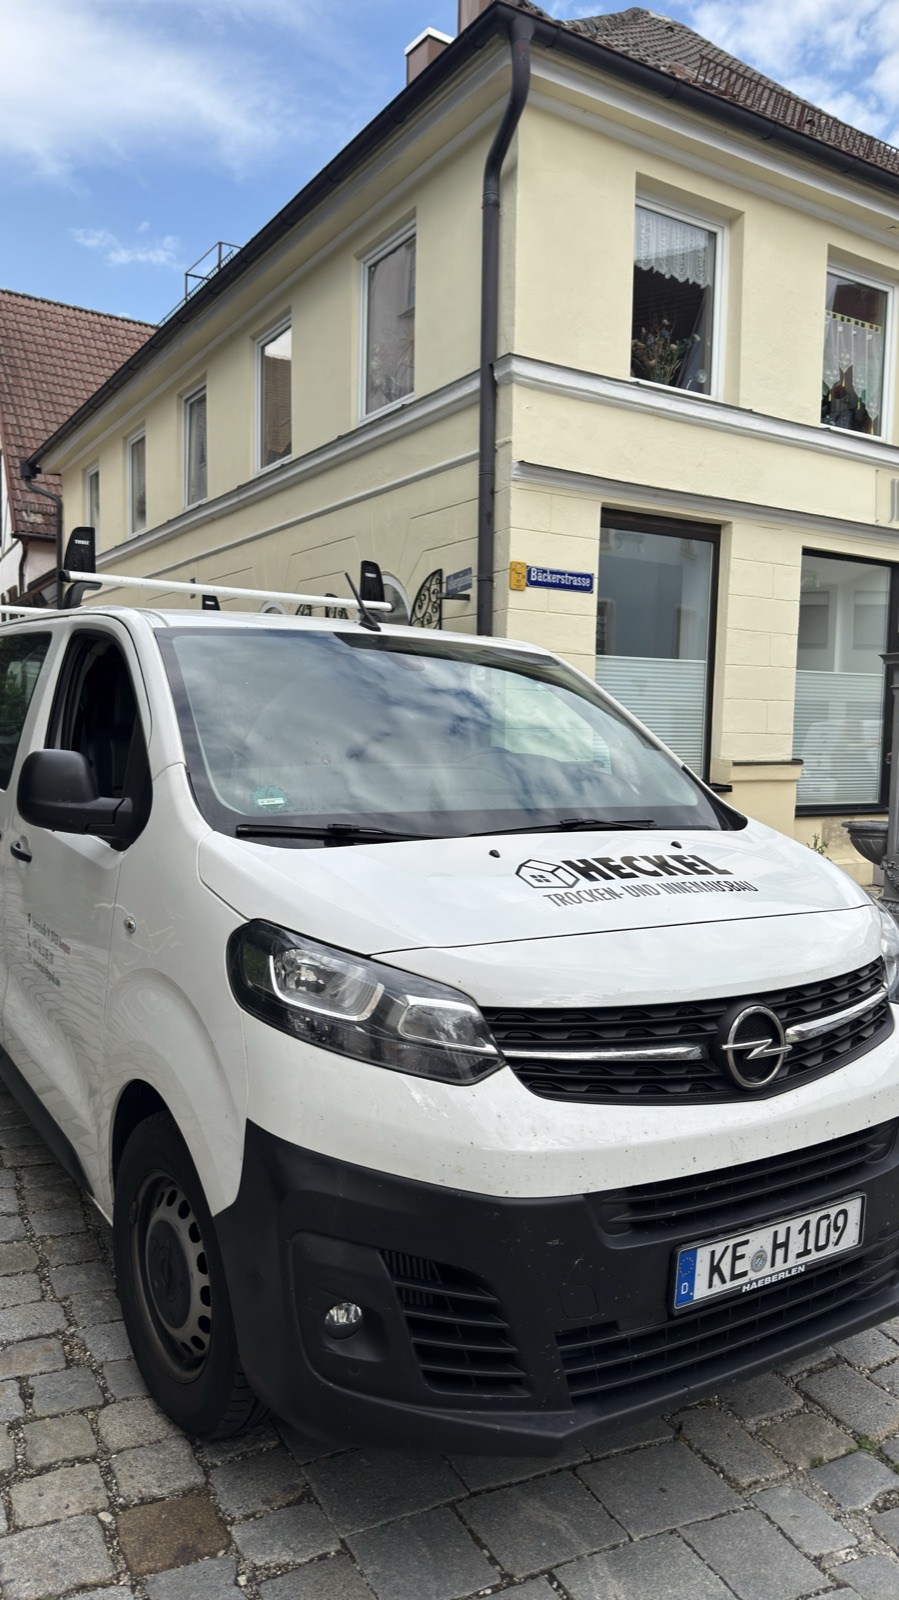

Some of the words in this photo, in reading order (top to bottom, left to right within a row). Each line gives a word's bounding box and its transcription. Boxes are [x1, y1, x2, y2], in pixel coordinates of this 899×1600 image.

[530, 567, 591, 586] Bäckerstrasse
[561, 854, 735, 882] HECKEL
[542, 886, 624, 907] TROCKEN-
[624, 883, 661, 898] UND
[659, 880, 759, 896] INNENAUSBAU
[707, 1239, 750, 1290] KE
[680, 1282, 689, 1295] D
[741, 1264, 806, 1294] HAEBERLEN
